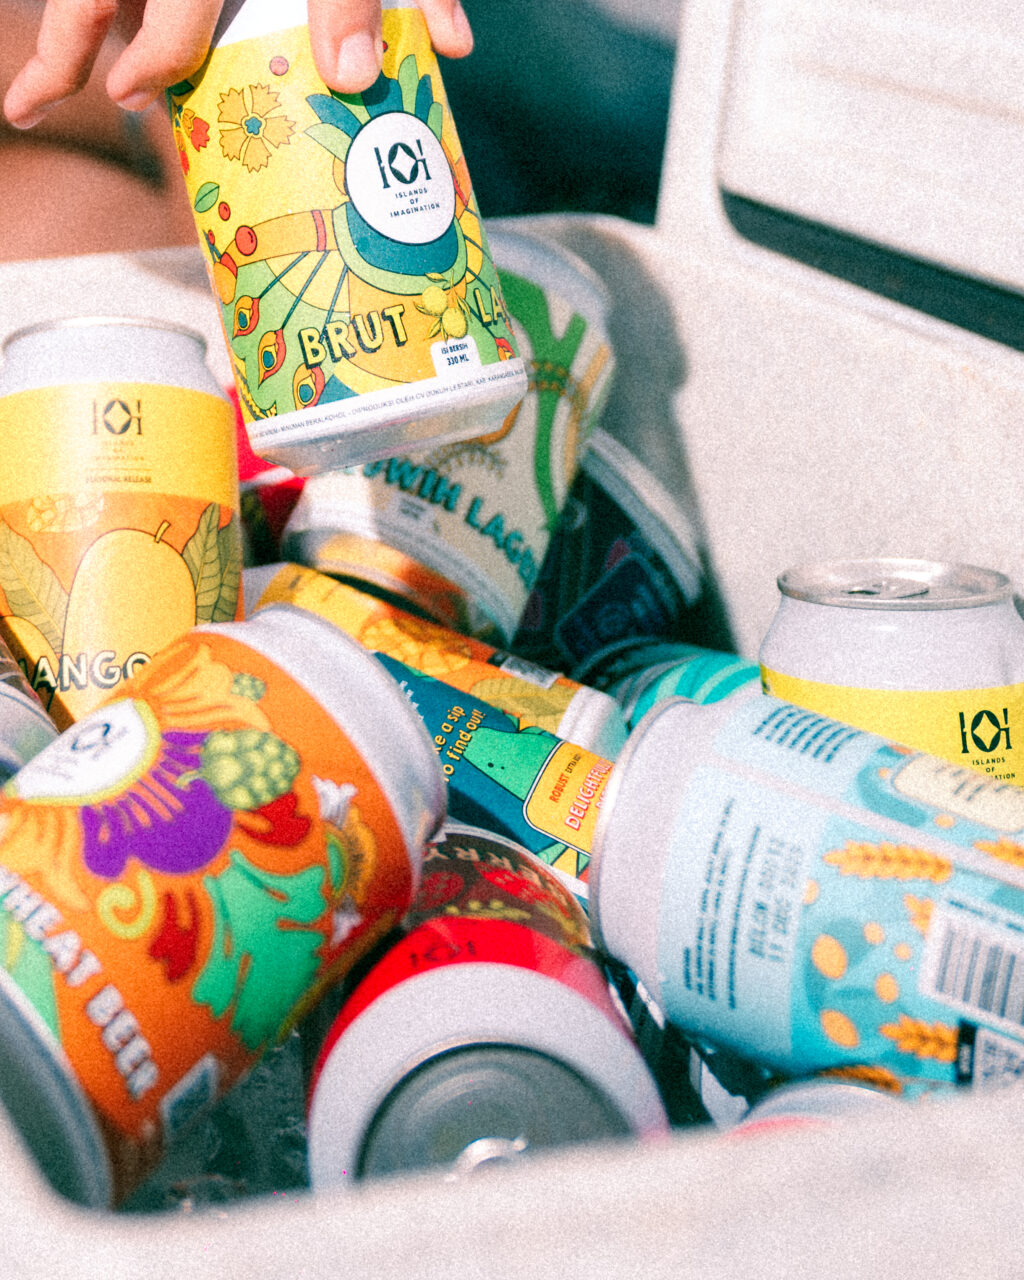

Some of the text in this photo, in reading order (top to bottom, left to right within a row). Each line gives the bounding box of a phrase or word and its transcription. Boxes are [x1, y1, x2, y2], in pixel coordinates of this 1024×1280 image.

[395, 187, 428, 199] ISLANDS
[409, 197, 419, 205] OF
[389, 202, 441, 218] IMAGINATION
[298, 304, 408, 369] BRUT
[441, 343, 469, 355] ISI BERSIH
[446, 354, 470, 366] 330 ML
[447, 705, 466, 724] sip
[441, 721, 454, 734] a
[447, 729, 473, 762] find
[972, 756, 1006, 766] ISLANDS
[549, 772, 571, 803] ROBUST
[85, 983, 159, 1101] BEER
